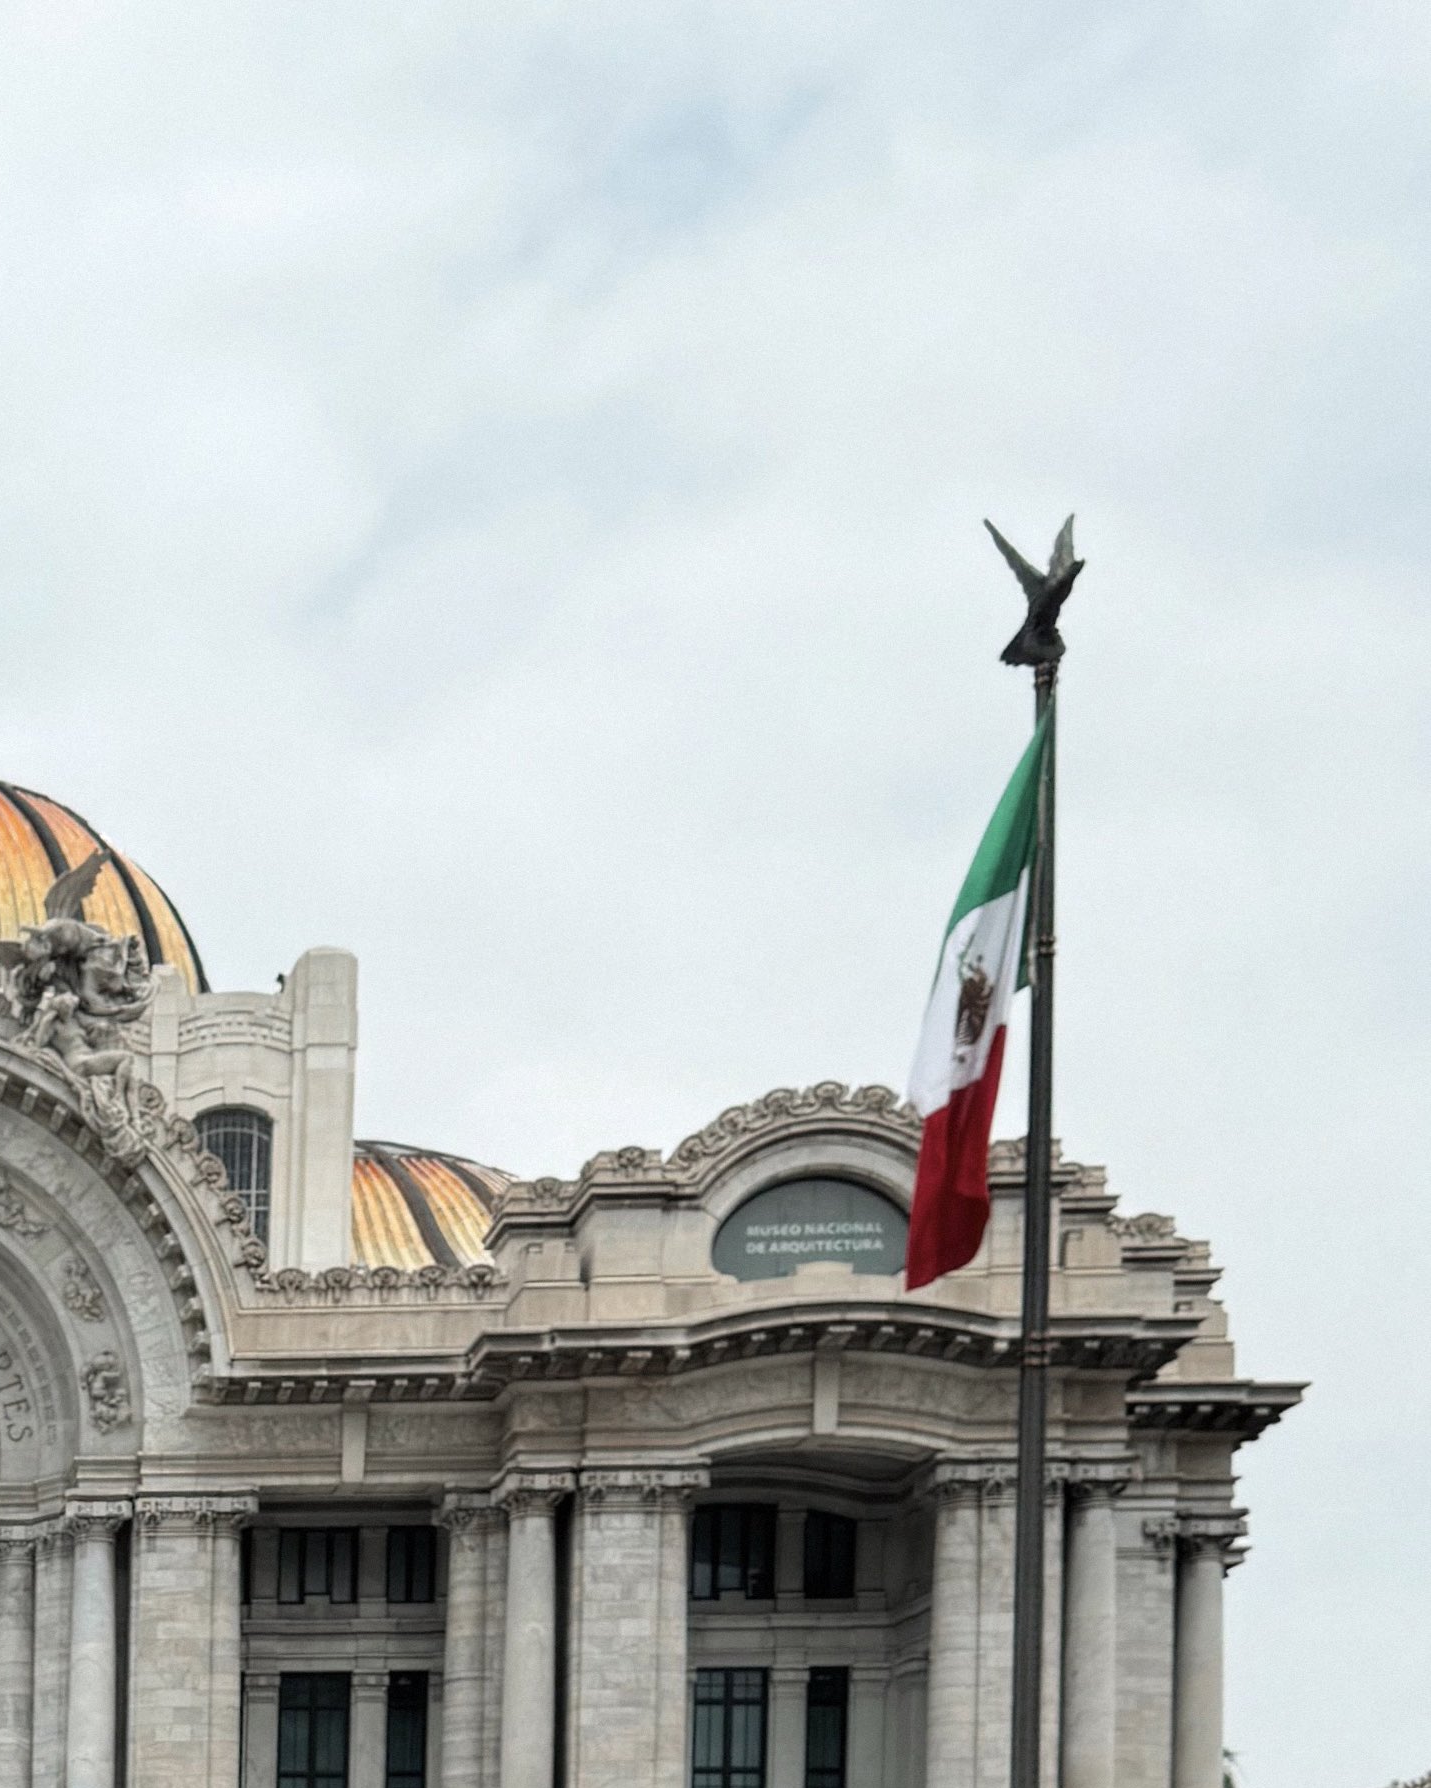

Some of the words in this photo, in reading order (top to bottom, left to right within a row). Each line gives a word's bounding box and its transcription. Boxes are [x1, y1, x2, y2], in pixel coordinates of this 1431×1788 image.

[745, 1223, 802, 1237] MUSEO
[804, 1222, 883, 1235] NACIONAL
[745, 1241, 766, 1255] DE
[768, 1239, 884, 1254] ARQUITECTURA
